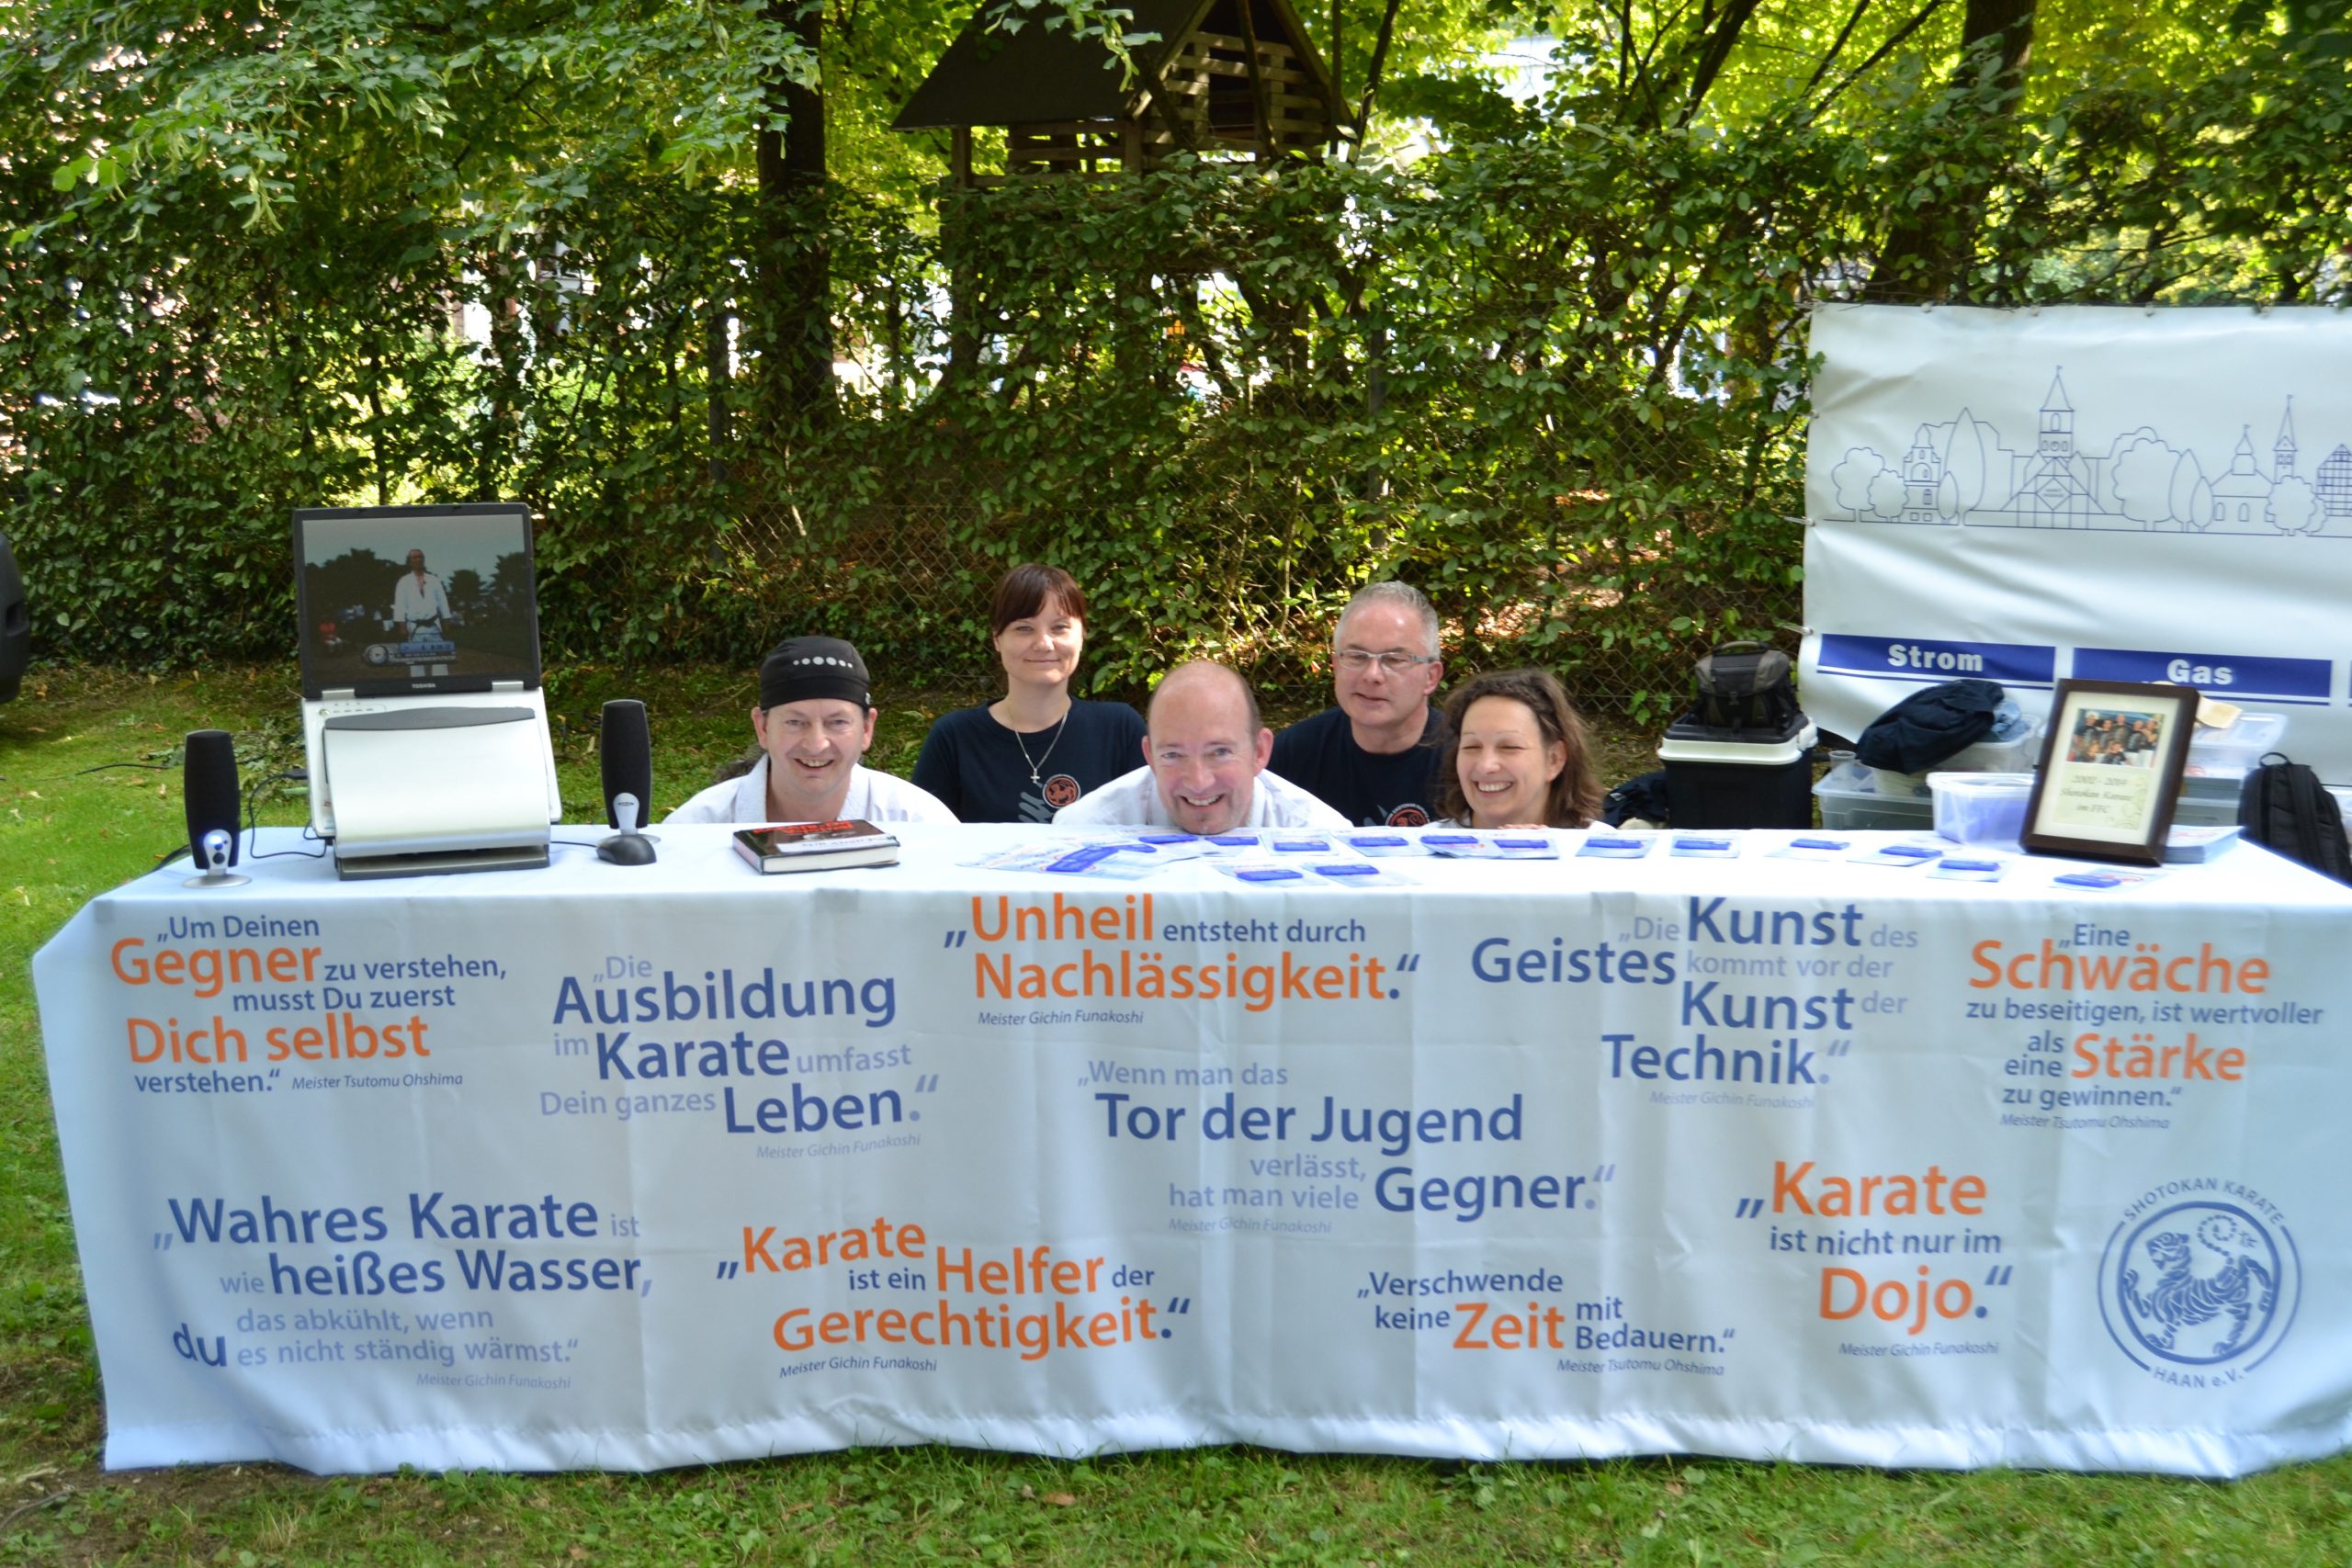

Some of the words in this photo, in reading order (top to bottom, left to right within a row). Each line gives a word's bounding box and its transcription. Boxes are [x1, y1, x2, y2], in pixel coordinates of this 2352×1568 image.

[1887, 644, 1983, 671] Strom
[2167, 660, 2233, 684] Gas
[158, 917, 215, 942] „Um
[224, 917, 319, 939] Deinen
[1163, 920, 1278, 942] entsteht
[1286, 919, 1366, 942] durch
[1618, 917, 1679, 942] „Die
[1688, 897, 1863, 946] Kunst
[1871, 924, 1917, 948] des
[2058, 924, 2131, 949] „Eine
[111, 938, 322, 998] Gegner
[324, 962, 356, 981] zu
[364, 954, 506, 981] verstehen,
[594, 955, 652, 983] „Die
[1472, 938, 1676, 985] Geistes
[1687, 951, 1786, 977] kommt
[1797, 955, 1839, 977] vor
[1847, 954, 1894, 978] der
[1969, 939, 2269, 993] Schwäche
[232, 989, 315, 1012] musst
[322, 987, 362, 1010] Du
[368, 986, 456, 1009] zuerst
[553, 968, 895, 1028] Ausbildung
[1682, 981, 1854, 1031] Kunst
[1861, 990, 1908, 1014] der
[1966, 1001, 1996, 1019] zu
[2005, 998, 2144, 1026] beseitigen,
[2153, 1001, 2183, 1022] ist
[2190, 1003, 2323, 1024] wertvoller
[978, 1011, 1025, 1025] Meister
[1028, 1010, 1071, 1024] Gichin
[1075, 1010, 1143, 1024] Funakoshi
[127, 1017, 248, 1063] Dich
[266, 1013, 430, 1061] selbst
[2028, 1030, 2064, 1053] als
[554, 1033, 588, 1056] im
[596, 1032, 789, 1080] Karate
[797, 1044, 912, 1075] umfasst
[2005, 1055, 2063, 1077] eine
[2072, 1032, 2245, 1080] Stärke
[292, 1076, 342, 1090] Meister
[344, 1076, 401, 1089] Tsutomu
[402, 1073, 463, 1087] Ohshima
[1078, 1061, 1166, 1089] „Wenn
[1174, 1064, 1233, 1085] man
[1242, 1063, 1288, 1085] das
[540, 1092, 607, 1116] Dein
[616, 1092, 717, 1121] ganzes
[2003, 1088, 2031, 1104] zu
[1095, 1092, 1186, 1138] Tor
[1202, 1092, 1295, 1142] der
[1311, 1094, 1522, 1156] Jugend
[2000, 1113, 2050, 1126] Meister
[2052, 1116, 2105, 1130] Tsutomu
[2108, 1115, 2170, 1130] Ohshima
[757, 1145, 804, 1159] Meister
[808, 1143, 850, 1156] Gichin
[853, 1134, 920, 1153] Funakoshi
[1250, 1154, 1367, 1182] verlässt,
[1169, 1184, 1214, 1207] hat
[1222, 1187, 1283, 1208] man
[1292, 1185, 1359, 1209] viele
[2124, 1178, 2218, 1221] SHOTOKAN
[2223, 1180, 2284, 1224] KARATE
[409, 1192, 598, 1241] Karate
[611, 1215, 639, 1238] ist
[1169, 1218, 1216, 1233] Meister
[1218, 1216, 1260, 1233] Gichin
[1263, 1218, 1331, 1234] Funakoshi
[1770, 1225, 1807, 1252] ist
[1816, 1228, 1894, 1256] nicht
[1902, 1233, 1956, 1254] nur
[1963, 1228, 2001, 1253] im
[220, 1273, 265, 1294] wie
[269, 1251, 445, 1296] heißes
[457, 1249, 652, 1298] Wasser,
[849, 1270, 879, 1290] ist
[888, 1268, 926, 1290] ein
[936, 1245, 1104, 1295] Helfer
[1113, 1265, 1154, 1288] der
[1356, 1269, 1563, 1299] „Verschwende
[236, 1309, 286, 1333] das
[293, 1308, 409, 1335] abkühlt,
[414, 1307, 494, 1331] wenn
[1375, 1306, 1450, 1329] keine
[1453, 1302, 1565, 1349] Zeit
[1576, 1298, 1623, 1320] mit
[173, 1323, 228, 1367] du
[238, 1344, 266, 1367] es
[277, 1340, 345, 1364] nicht
[356, 1338, 455, 1367] ständig
[1838, 1342, 1887, 1356] Meister
[1891, 1343, 1930, 1356] Gichin
[1933, 1341, 1999, 1355] Funakoshi
[416, 1373, 462, 1387] Meister
[464, 1374, 506, 1388] Gichin
[508, 1375, 571, 1389] Funakoshi
[779, 1359, 826, 1378] Meister
[830, 1356, 869, 1370] Gichin
[873, 1357, 937, 1372] Funakoshi
[1557, 1359, 1604, 1374] Meister
[1608, 1359, 1661, 1371] Tsutomu
[1665, 1359, 1724, 1375] Ohshima
[2154, 1367, 2205, 1388] HAAN
